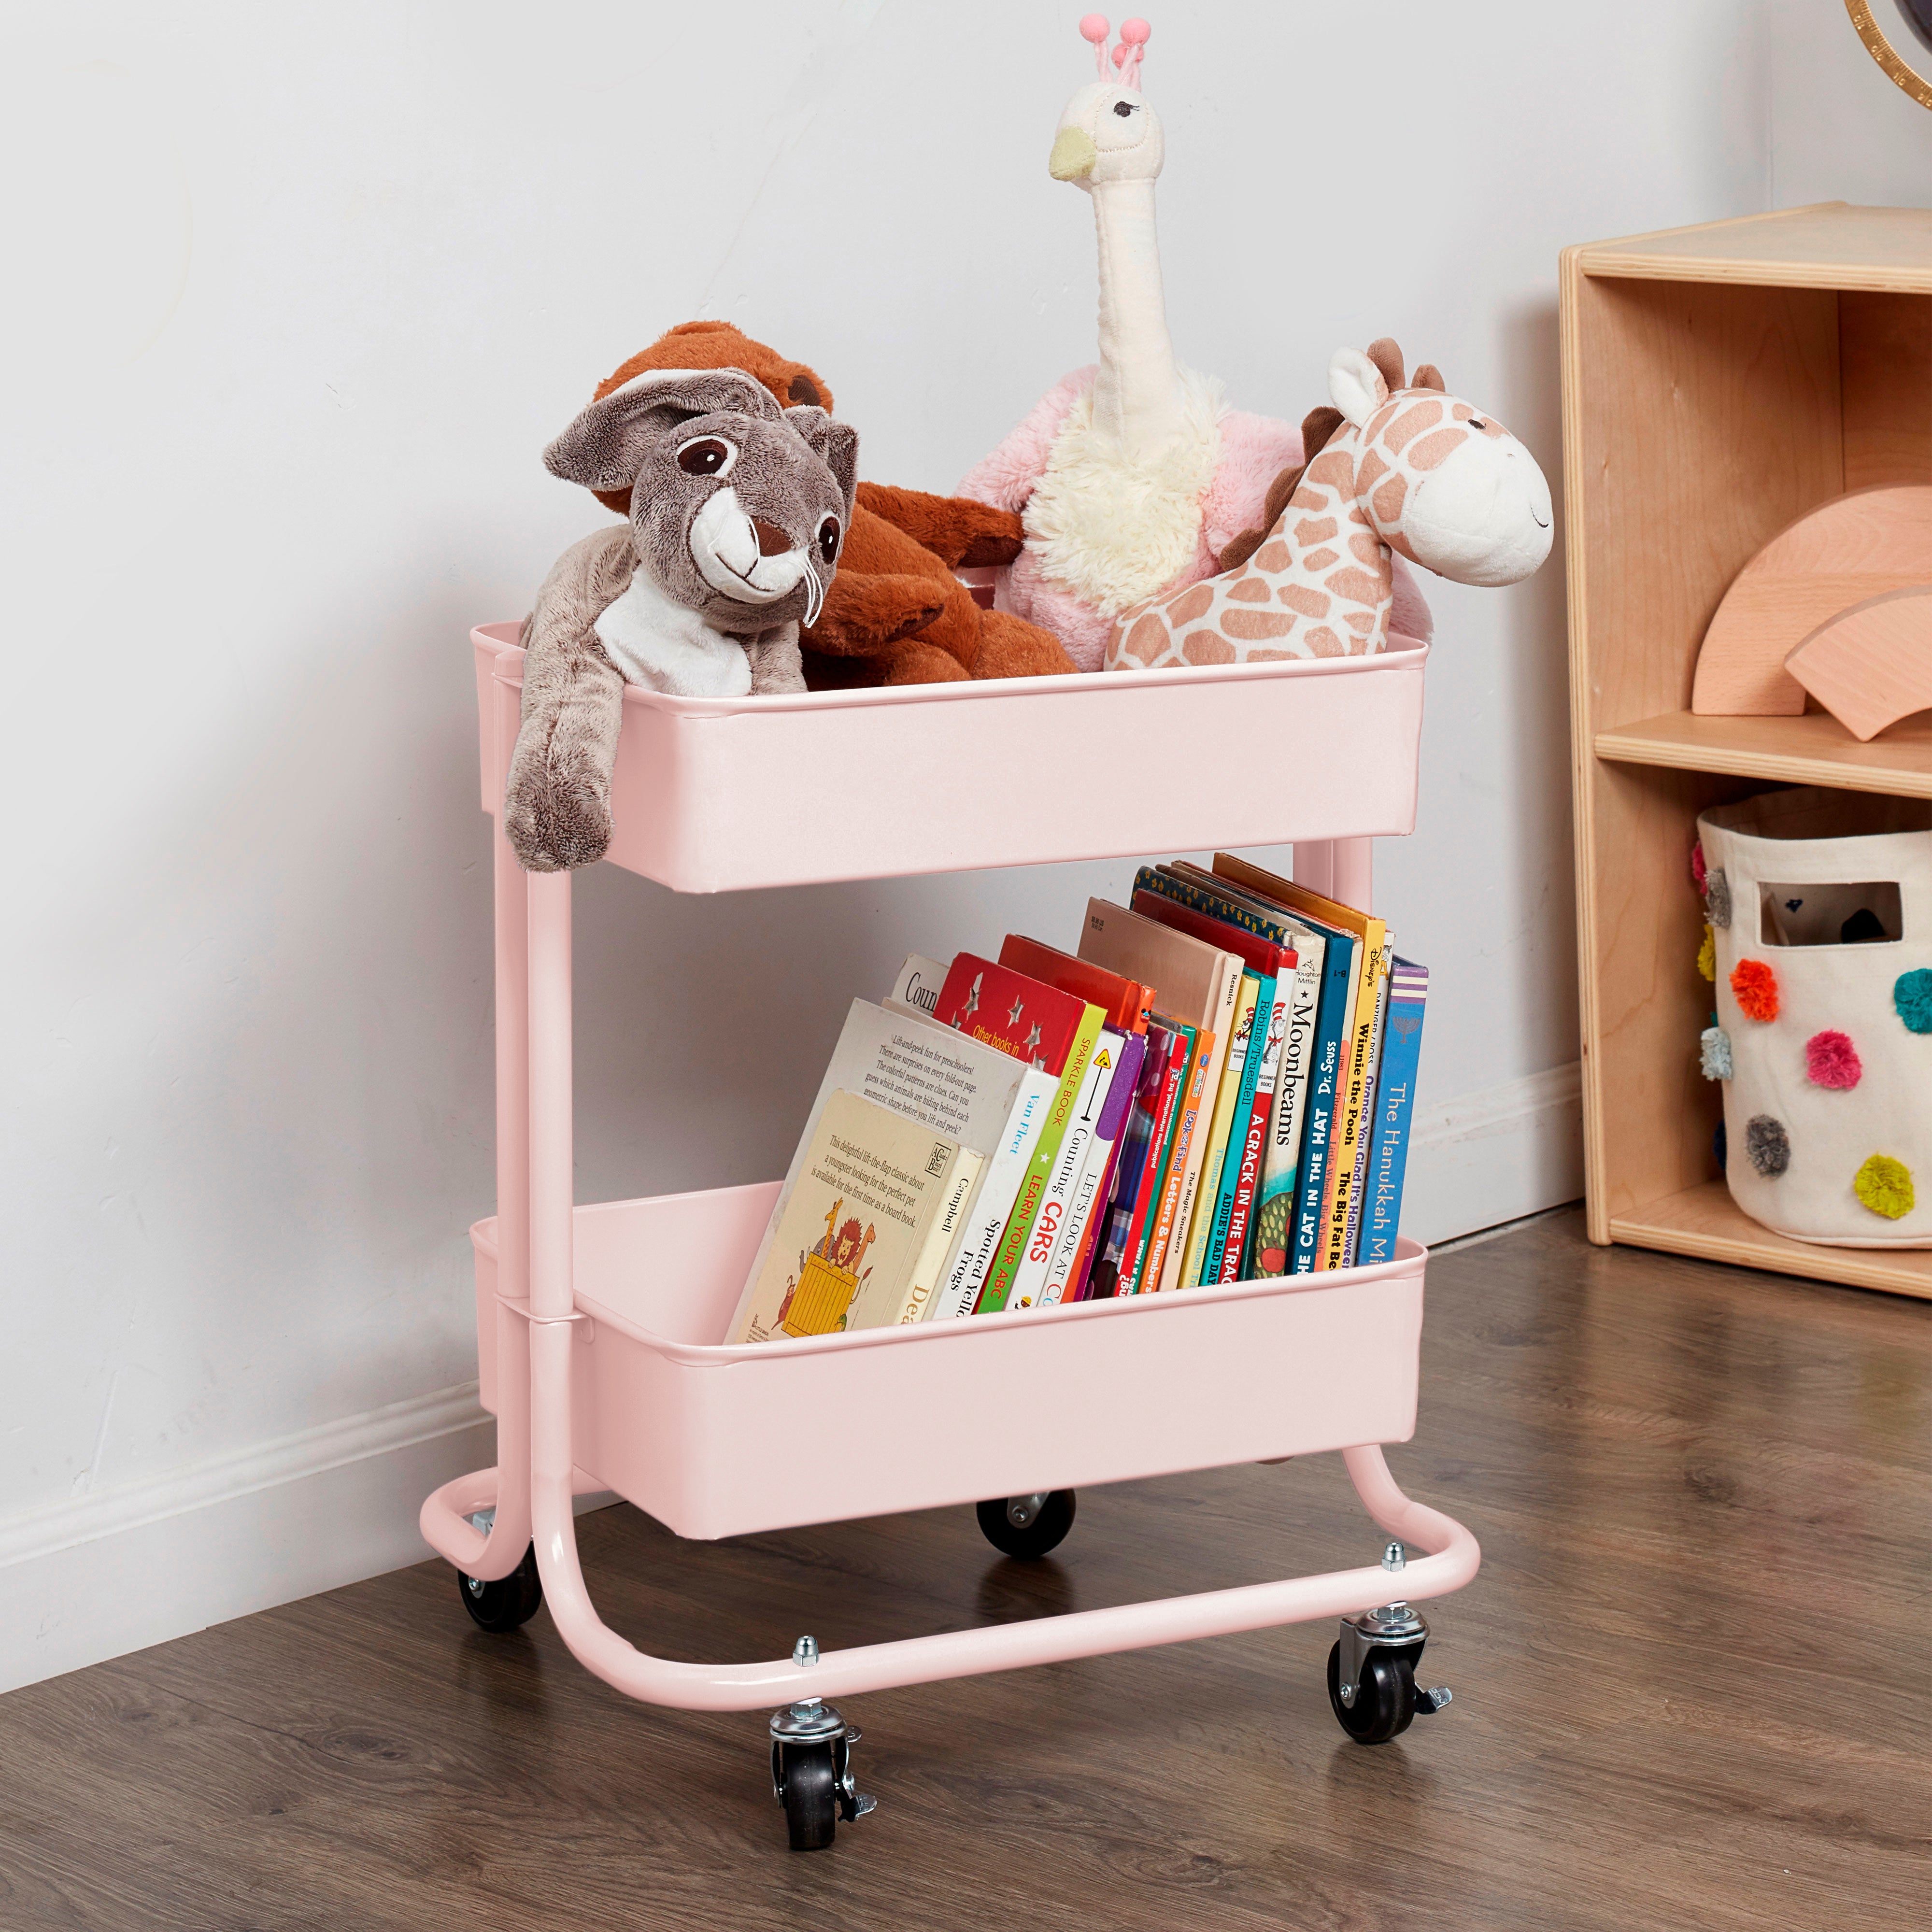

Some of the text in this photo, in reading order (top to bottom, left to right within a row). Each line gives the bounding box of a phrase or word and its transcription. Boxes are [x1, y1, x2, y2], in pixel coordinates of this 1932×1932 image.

[905, 972, 938, 1012] Coun
[1226, 974, 1237, 1006] Resnick
[893, 1035, 974, 1075] Lift-and-peek fun for preschoolers!
[973, 1025, 1019, 1056] Other books in
[1241, 999, 1270, 1106] Robins/Truesdell
[876, 1060, 969, 1106] The colorful patterns are clues. Can you
[879, 1045, 893, 1058] There
[893, 1053, 901, 1061] are
[902, 1055, 923, 1070] surprises
[931, 1068, 944, 1080] every
[945, 1071, 964, 1088] fold-out
[964, 1082, 977, 1094] page.
[1052, 1038, 1090, 1126] SPARKLE BOOK
[1277, 1003, 1313, 1146] Moonbeams
[1318, 1041, 1336, 1094] Dr. Seuss
[1345, 1023, 1369, 1146] Winnie the Pooh
[864, 1088, 887, 1104] geometric
[887, 1097, 902, 1110] shape
[902, 1102, 918, 1116] before
[916, 1111, 927, 1121] you
[936, 1118, 946, 1129] and
[945, 1122, 961, 1135] peek?
[865, 1073, 969, 1122] guess which animals are hiding behind each
[1331, 1092, 1341, 1129] Fitzgerald
[1361, 1075, 1374, 1123] Orange
[1386, 1082, 1406, 1122] The
[1010, 1095, 1040, 1154] Van Fleet
[1151, 1131, 1163, 1169] publications
[1159, 1092, 1173, 1130] international,
[1183, 1110, 1196, 1134] Look
[1252, 1114, 1264, 1126] A
[1312, 1108, 1328, 1145] HAT
[1357, 1125, 1368, 1150] You
[829, 1135, 924, 1191] This delightful lift-the-flap classic about
[1173, 1146, 1187, 1171] Find
[1209, 1148, 1224, 1190] Thomas
[1241, 1129, 1261, 1184] CRACK
[1309, 1152, 1322, 1182] THE
[1326, 1141, 1336, 1166] Little
[1352, 1151, 1365, 1182] Glad
[811, 1165, 816, 1176] is
[816, 1169, 837, 1187] available
[836, 1178, 845, 1191] for
[843, 1183, 852, 1194] the
[852, 1186, 863, 1200] first
[862, 1191, 875, 1207] time
[874, 1200, 881, 1209] as
[885, 1206, 902, 1222] board
[901, 1214, 916, 1228] book.
[826, 1157, 852, 1174] youngster
[852, 1165, 871, 1184] looking
[869, 1175, 879, 1187] for
[878, 1179, 887, 1193] the
[885, 1186, 907, 1204] perfect
[905, 1195, 916, 1207] pet
[1030, 1128, 1088, 1264] Counting CARS
[1076, 1172, 1097, 1212] LET'S
[1237, 1190, 1250, 1206] IN
[1307, 1189, 1318, 1207] IN
[1338, 1171, 1350, 1196] The
[1350, 1185, 1361, 1203] It's
[1373, 1130, 1400, 1229] Hanukkah
[942, 1178, 968, 1232] Campbell
[1183, 1189, 1192, 1213] Magic
[1205, 1193, 1214, 1212] and
[1321, 1204, 1329, 1219] Big
[1332, 1201, 1347, 1222] Big
[991, 1175, 1043, 1299] LEARN YOUR ABC
[1061, 1215, 1083, 1256] LOOK
[1145, 1177, 1180, 1293] Letters & Numbers
[1175, 1216, 1186, 1254] Sneakers
[1201, 1215, 1210, 1232] the
[1207, 1192, 1233, 1284] ADDIE'S BAD DAY
[1230, 1210, 1245, 1239] THE
[1300, 1213, 1315, 1247] CAT
[1317, 1222, 1327, 1254] Wheels
[1331, 1227, 1343, 1247] Fat
[971, 1219, 1001, 1279] Spotted
[1055, 1258, 1067, 1279] AT
[1194, 1235, 1207, 1270] School
[950, 1250, 974, 1291] Frogs
